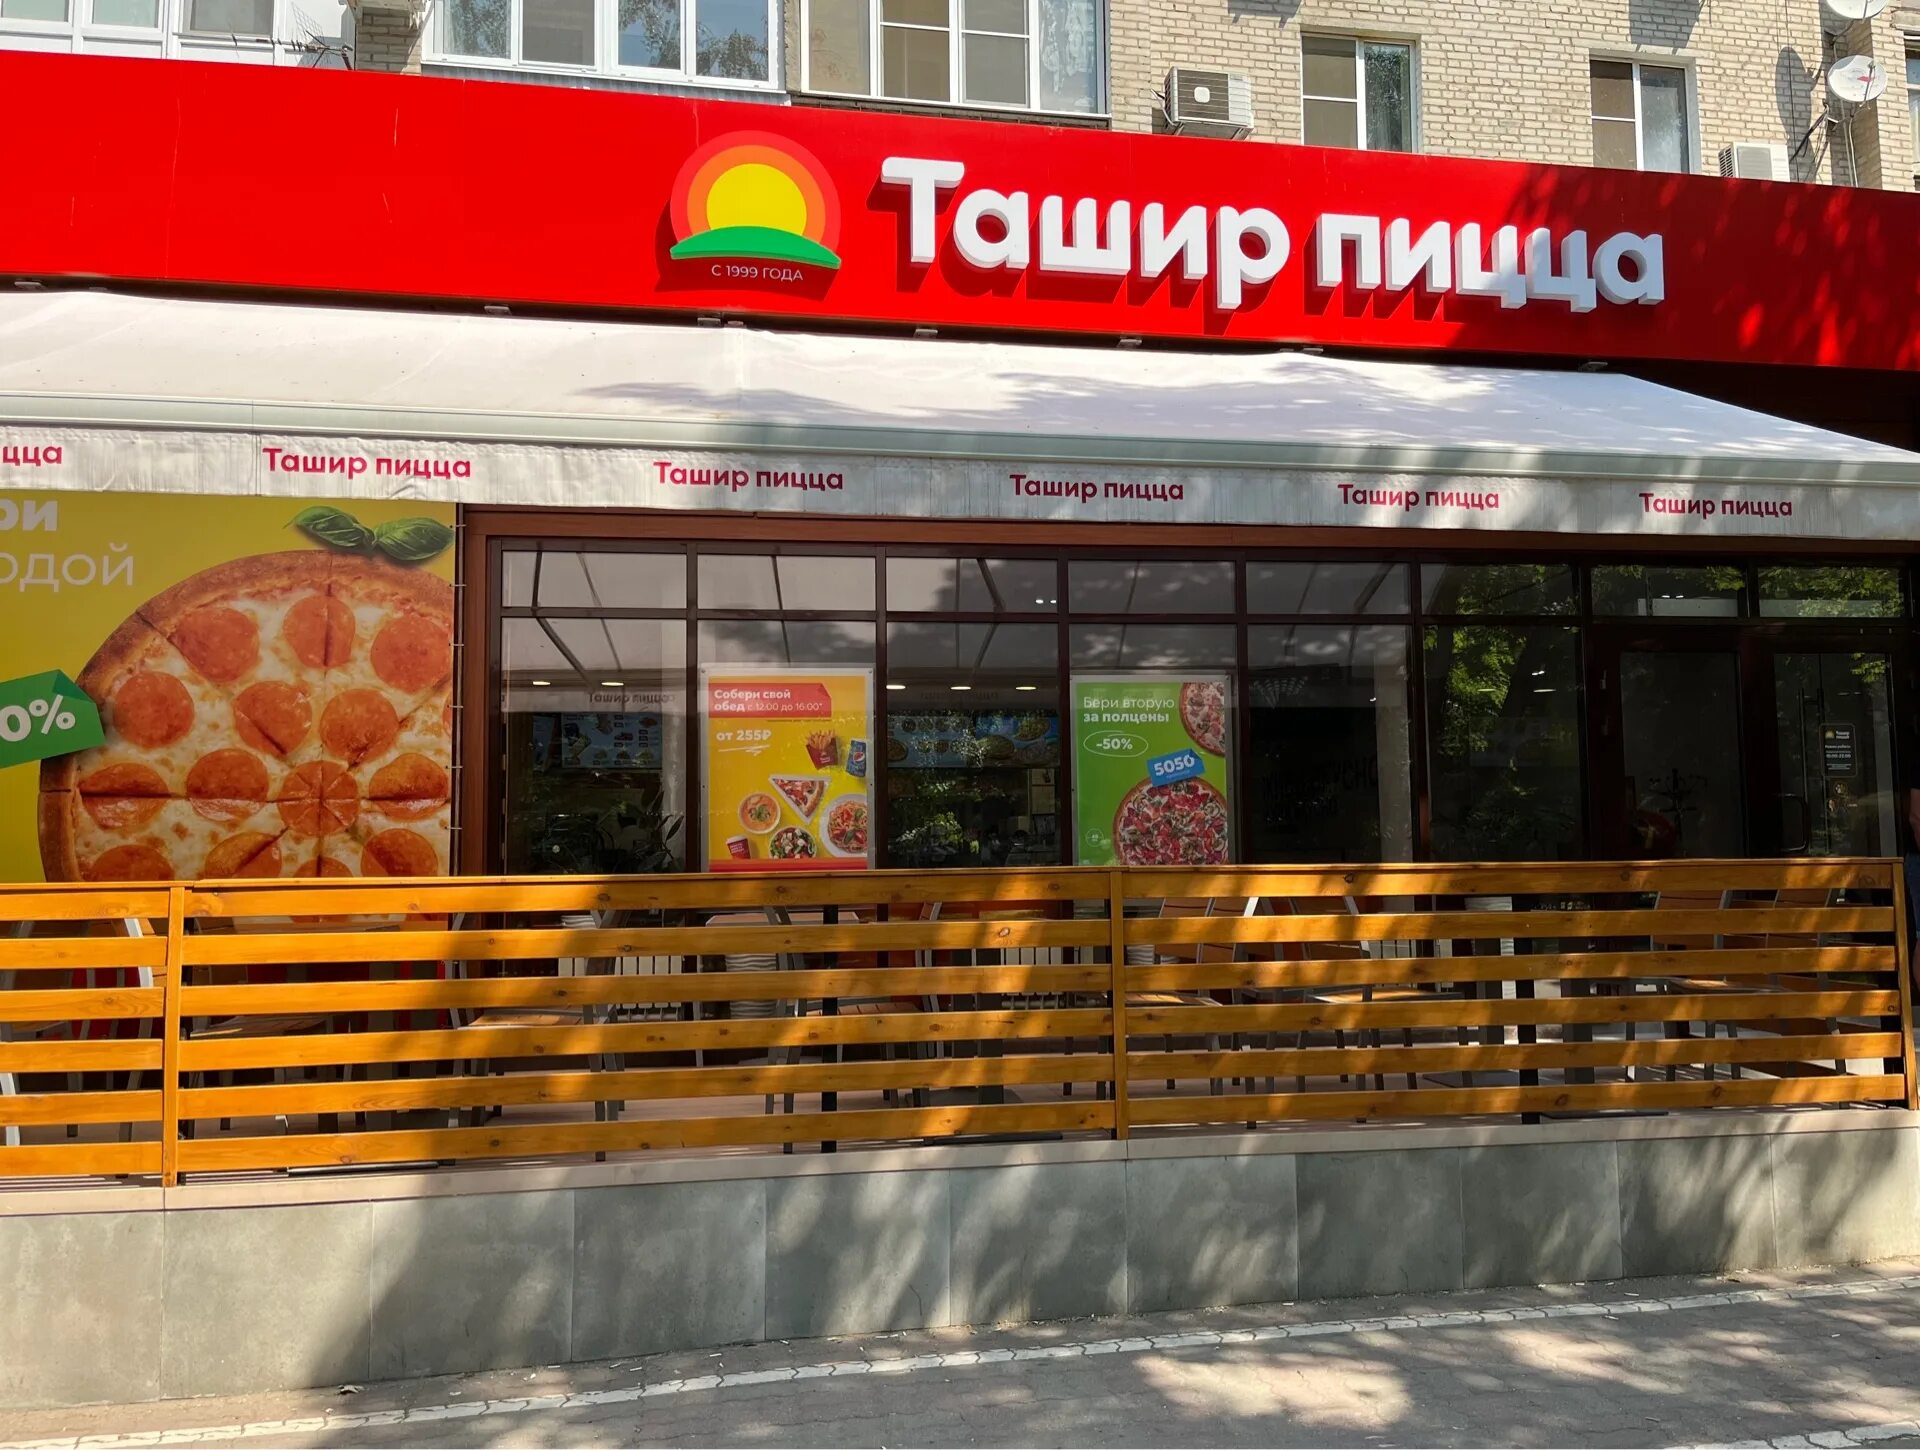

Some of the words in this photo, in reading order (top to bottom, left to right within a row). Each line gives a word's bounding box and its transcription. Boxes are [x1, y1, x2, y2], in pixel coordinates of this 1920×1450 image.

[881, 156, 1290, 309] Ташир
[1316, 212, 1664, 313] пицца
[711, 264, 722, 277] С
[725, 265, 758, 279] 1999
[762, 267, 804, 282] ГОДА
[262, 447, 368, 480] Ташир
[375, 457, 471, 480] пицца
[653, 461, 749, 492] Ташир
[756, 470, 843, 491] пицца
[1009, 474, 1098, 503] Ташир
[1104, 482, 1184, 502] пицца
[1337, 484, 1420, 512] Ташир
[1425, 491, 1499, 511] пицца
[1638, 493, 1716, 519] Ташир
[1721, 499, 1793, 518] пицца
[714, 689, 761, 701] Собери
[763, 689, 791, 699] свой
[1083, 696, 1119, 711] Бери
[1122, 698, 1175, 711] вторую
[714, 700, 746, 713] обед
[781, 704, 793, 712] до
[1083, 713, 1099, 723] за
[1102, 713, 1169, 725] полцены
[716, 732, 733, 741] от
[1095, 738, 1133, 750] -50%
